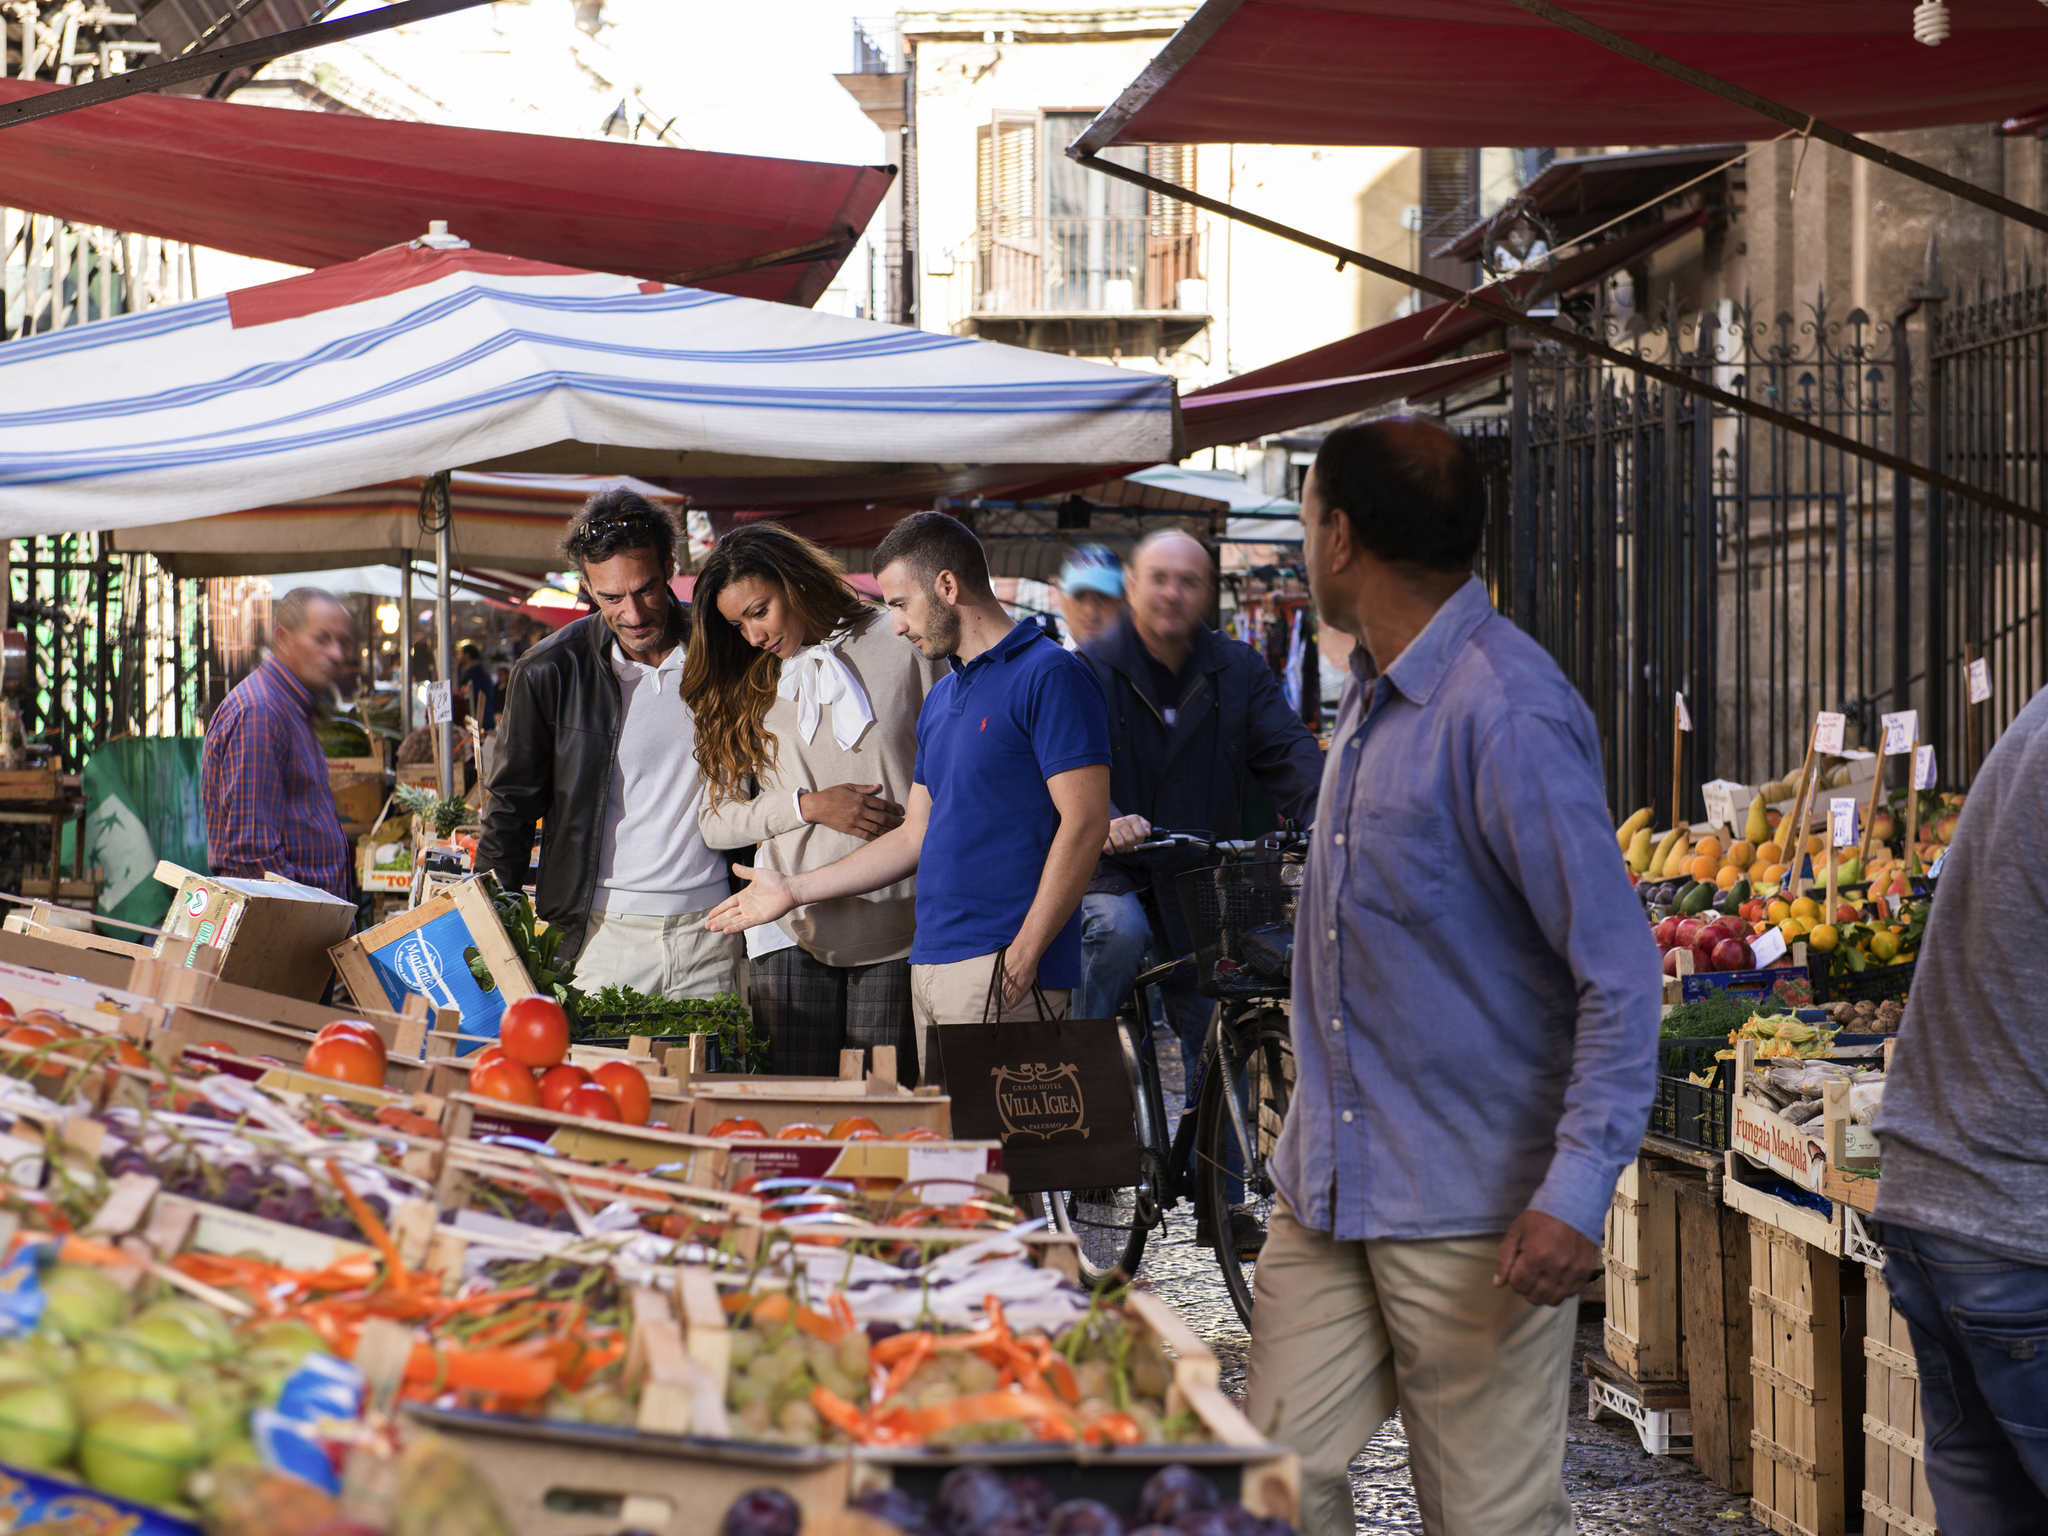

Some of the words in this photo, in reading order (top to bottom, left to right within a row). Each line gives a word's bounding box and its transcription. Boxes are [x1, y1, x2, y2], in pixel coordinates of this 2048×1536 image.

[404, 942, 434, 985] Marlene
[1000, 1093, 1041, 1117] VILLA
[1041, 1091, 1080, 1114] IGIEA
[1012, 1083, 1038, 1091] GRAND
[1735, 1108, 1770, 1155] Fungaia
[1771, 1125, 1807, 1172] Mendola
